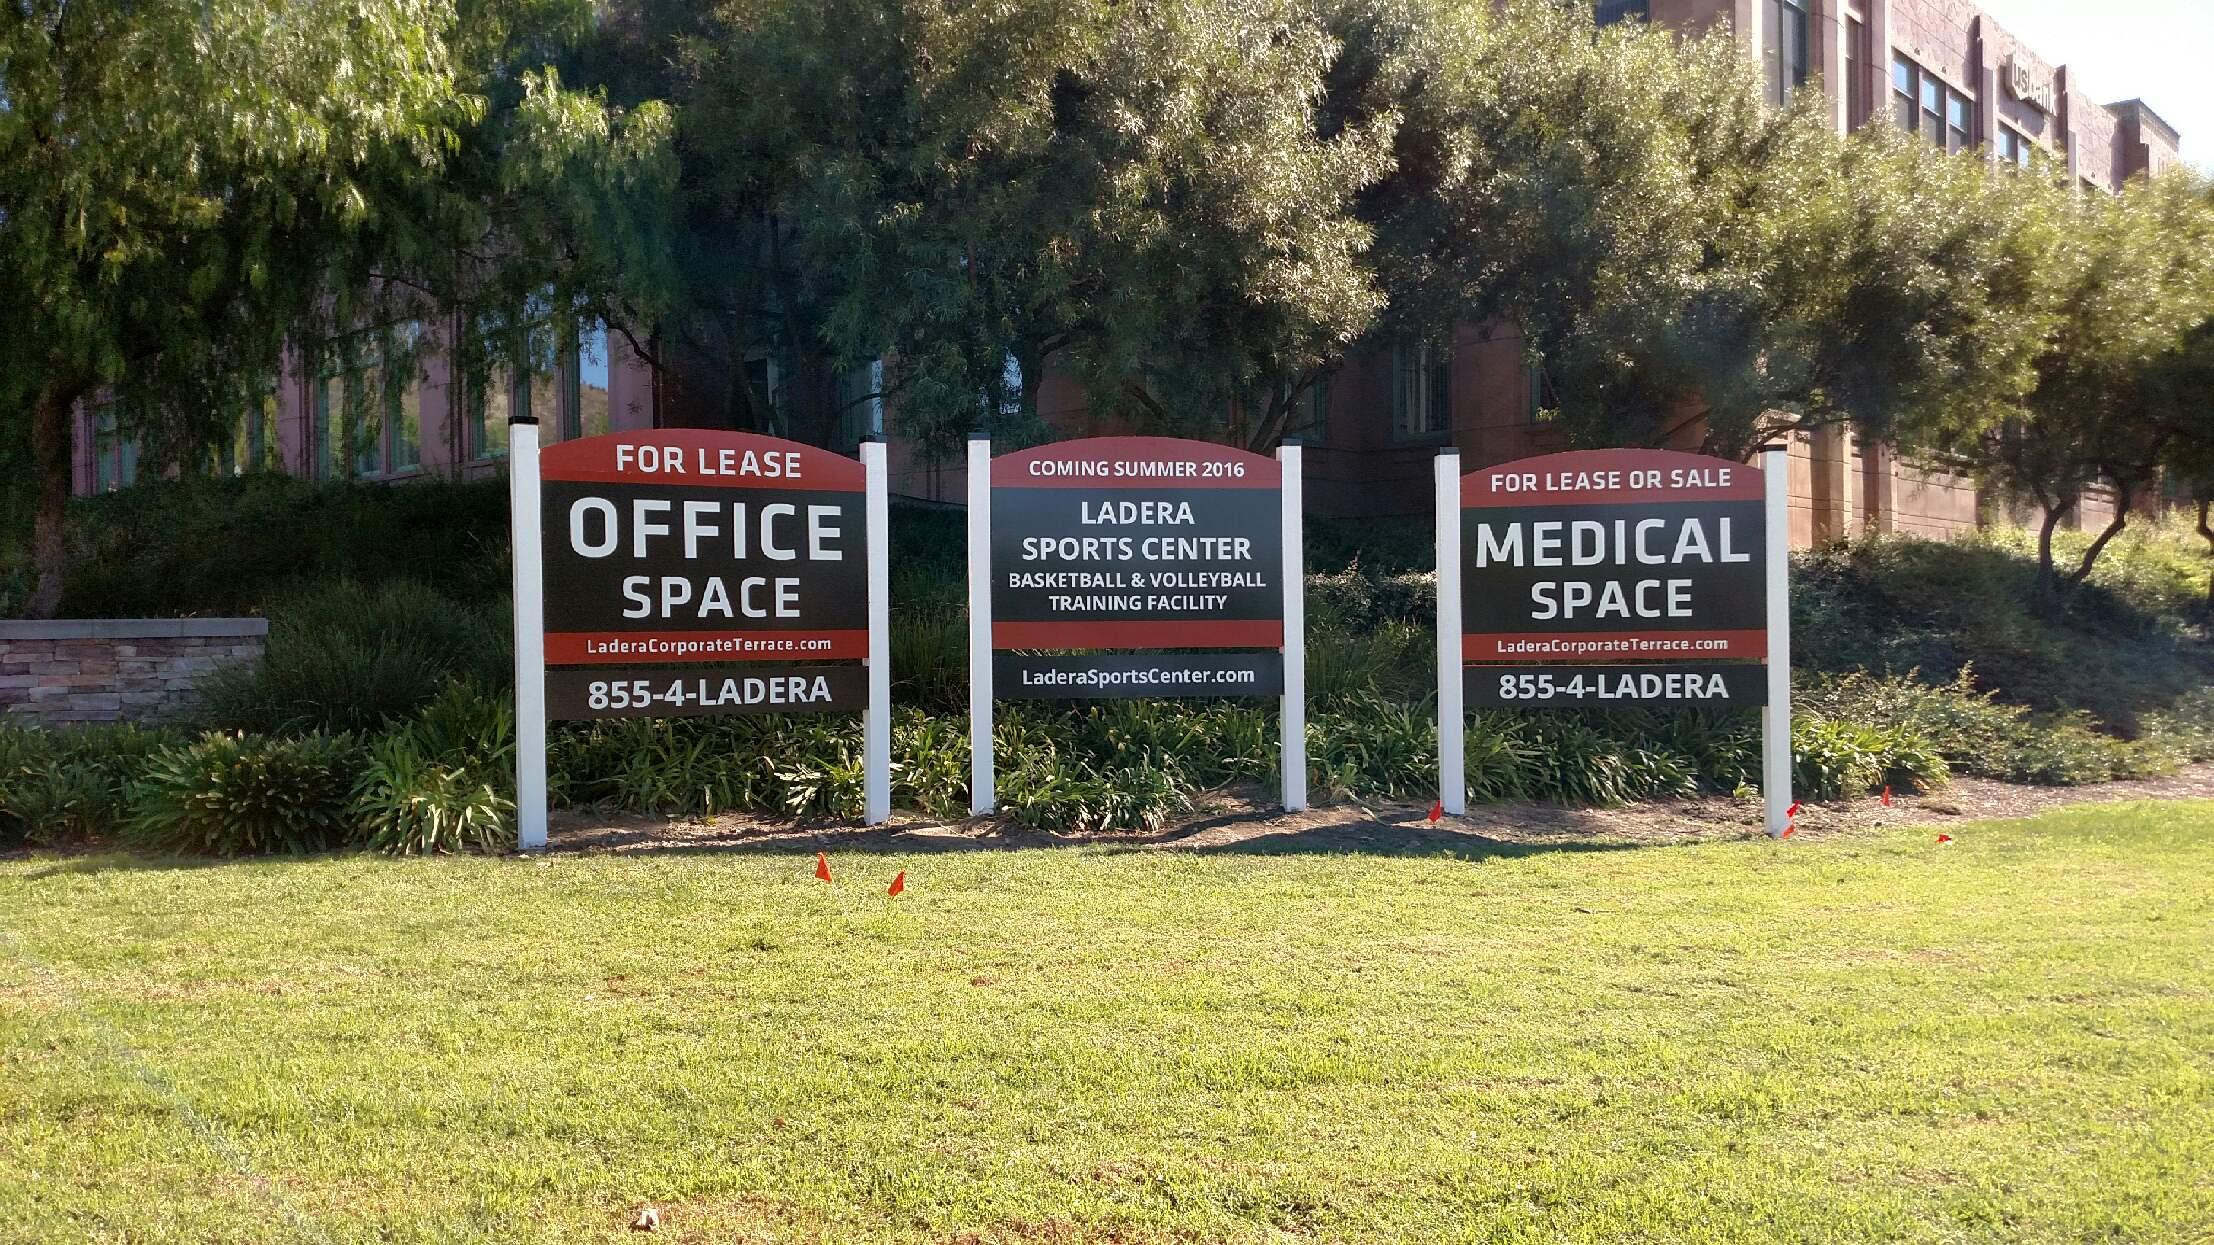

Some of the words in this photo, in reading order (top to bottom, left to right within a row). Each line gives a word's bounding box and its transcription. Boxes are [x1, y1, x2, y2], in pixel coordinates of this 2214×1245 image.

[616, 444, 687, 474] FOR
[698, 448, 802, 478] LEASE
[1029, 460, 1109, 477] COMING
[1113, 461, 1197, 477] SUMMER
[1201, 461, 1245, 478] 2016
[1491, 473, 1537, 493] FOR
[1546, 471, 1621, 491] LEASE
[1629, 470, 1663, 489] OR
[1670, 468, 1731, 488] SALE
[1081, 501, 1196, 525] LADERA
[569, 496, 843, 561] OFFICE
[1022, 537, 1133, 561] SPORTS
[1141, 537, 1252, 561] CENTER
[1476, 516, 1751, 568] MEDICAL
[1009, 572, 1127, 588] BASKETBALL
[1130, 572, 1146, 588] &
[1149, 572, 1267, 588] VOLLEYBALL
[622, 575, 801, 619] SPACE
[1048, 595, 1142, 611] TRAINING
[1147, 595, 1228, 611] FACILITY
[1531, 578, 1693, 620] SPACE
[587, 637, 831, 656] LaderaCorporateTerrace.com
[1497, 638, 1729, 655] LaderaCorporateTerrace.com
[1022, 668, 1255, 689] LaderaSportsCenter.com
[1499, 673, 1730, 699] 855-4-LADERA
[588, 675, 833, 710] 855-4-LADERA
